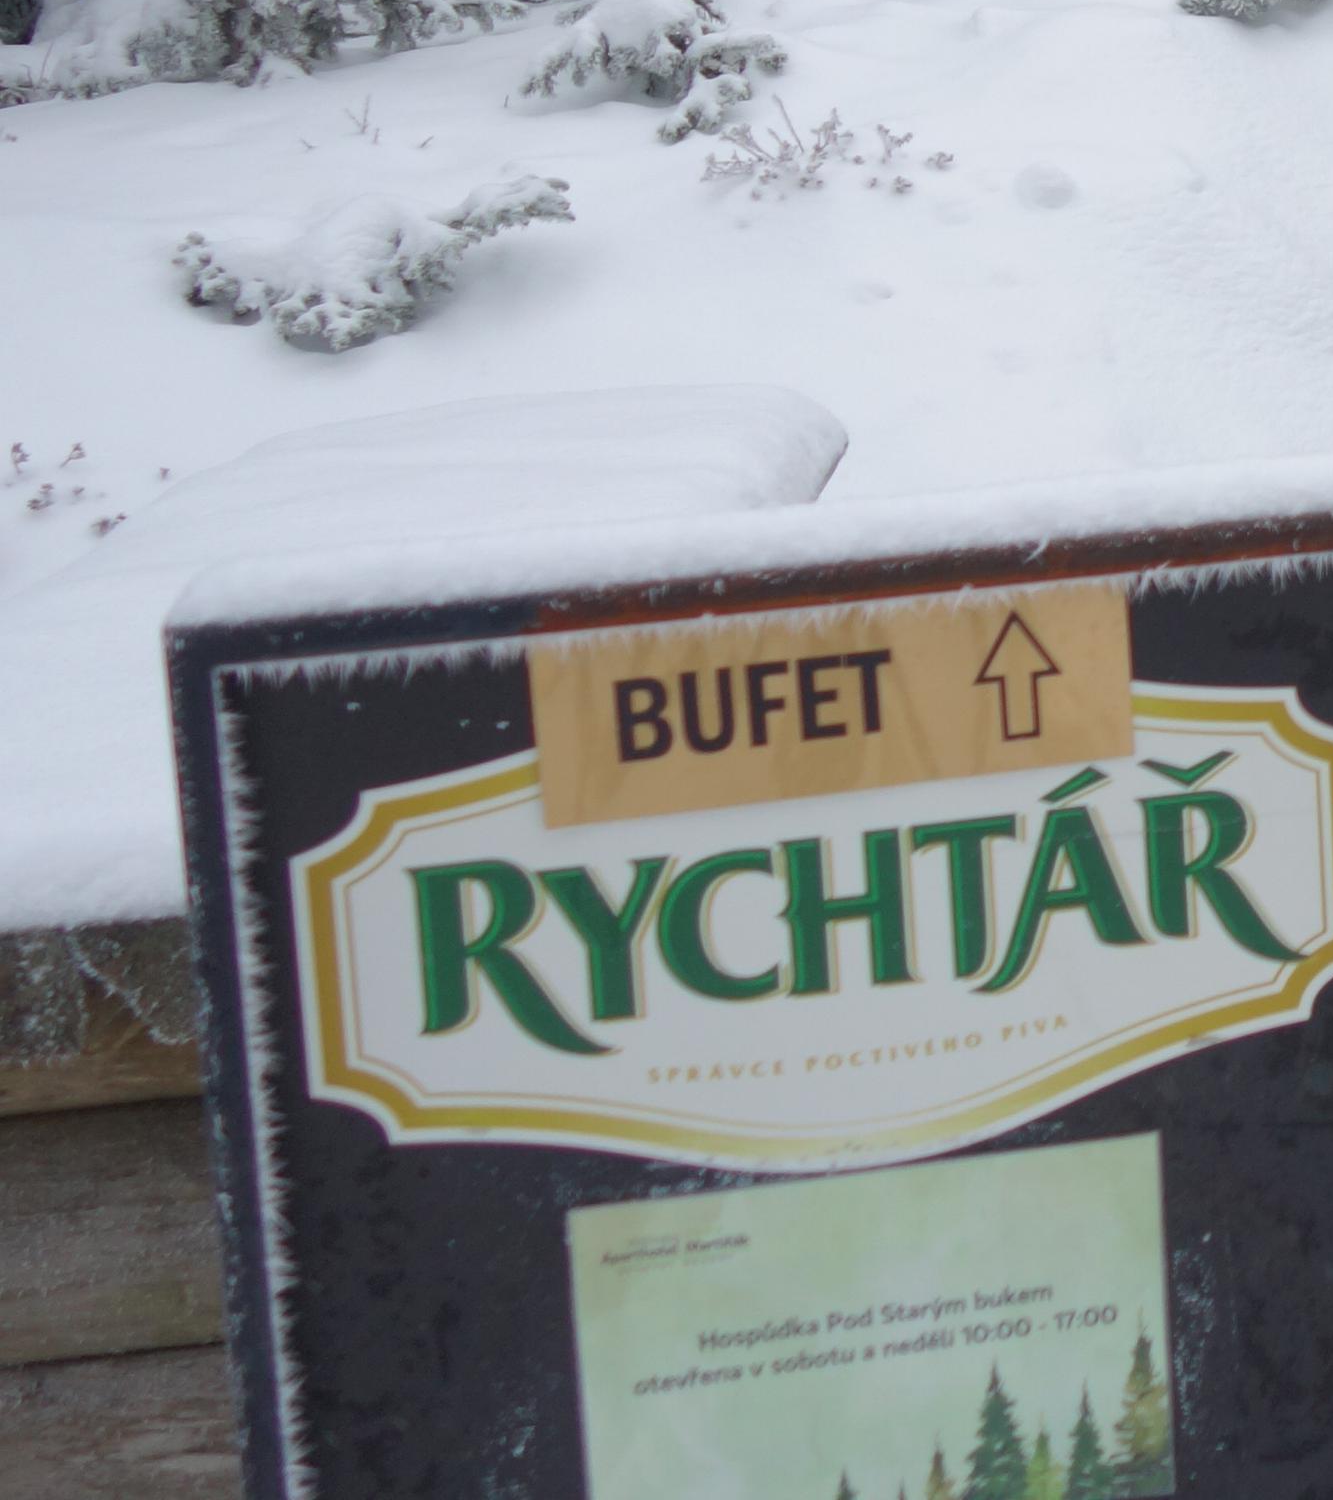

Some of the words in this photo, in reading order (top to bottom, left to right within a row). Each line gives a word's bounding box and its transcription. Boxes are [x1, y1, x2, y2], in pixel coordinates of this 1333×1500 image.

[612, 647, 892, 764] BUFET
[405, 749, 1312, 1056] RYCHTÁŘ
[1000, 1013, 1069, 1042] PIVA
[749, 1361, 765, 1378] v
[771, 1347, 856, 1375] sobotu
[862, 1345, 875, 1361] a
[882, 1327, 955, 1359] neděli
[962, 1318, 1032, 1345] 10:00
[1053, 1304, 1119, 1331] 17:00
[826, 1308, 874, 1333] Pod
[880, 1297, 966, 1323] Starým
[974, 1285, 1053, 1310] bukem
